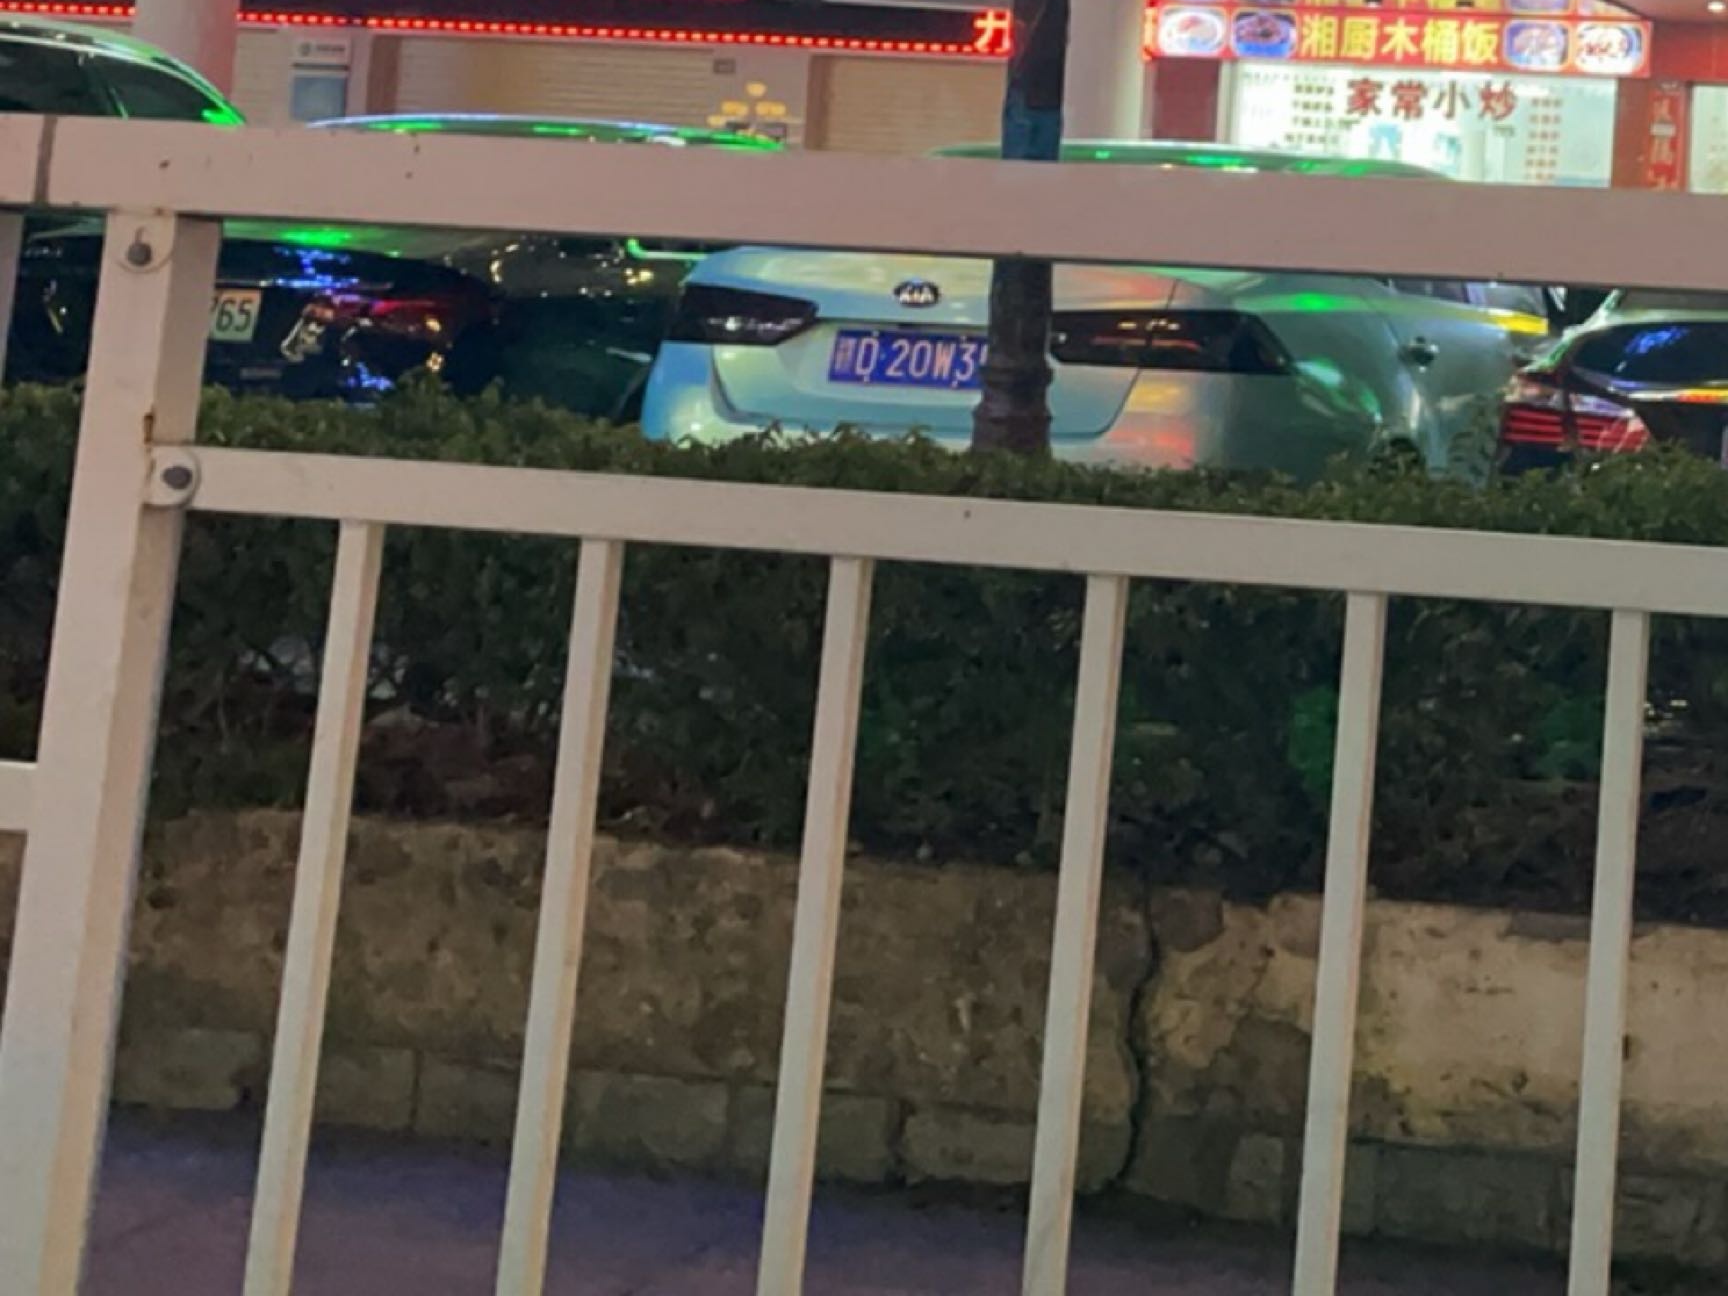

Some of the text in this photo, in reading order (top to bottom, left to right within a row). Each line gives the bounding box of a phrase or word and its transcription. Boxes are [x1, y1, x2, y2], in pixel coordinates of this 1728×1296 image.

[1302, 14, 1500, 64] 湘厨木桶饭
[1346, 77, 1518, 121] 家常小炒
